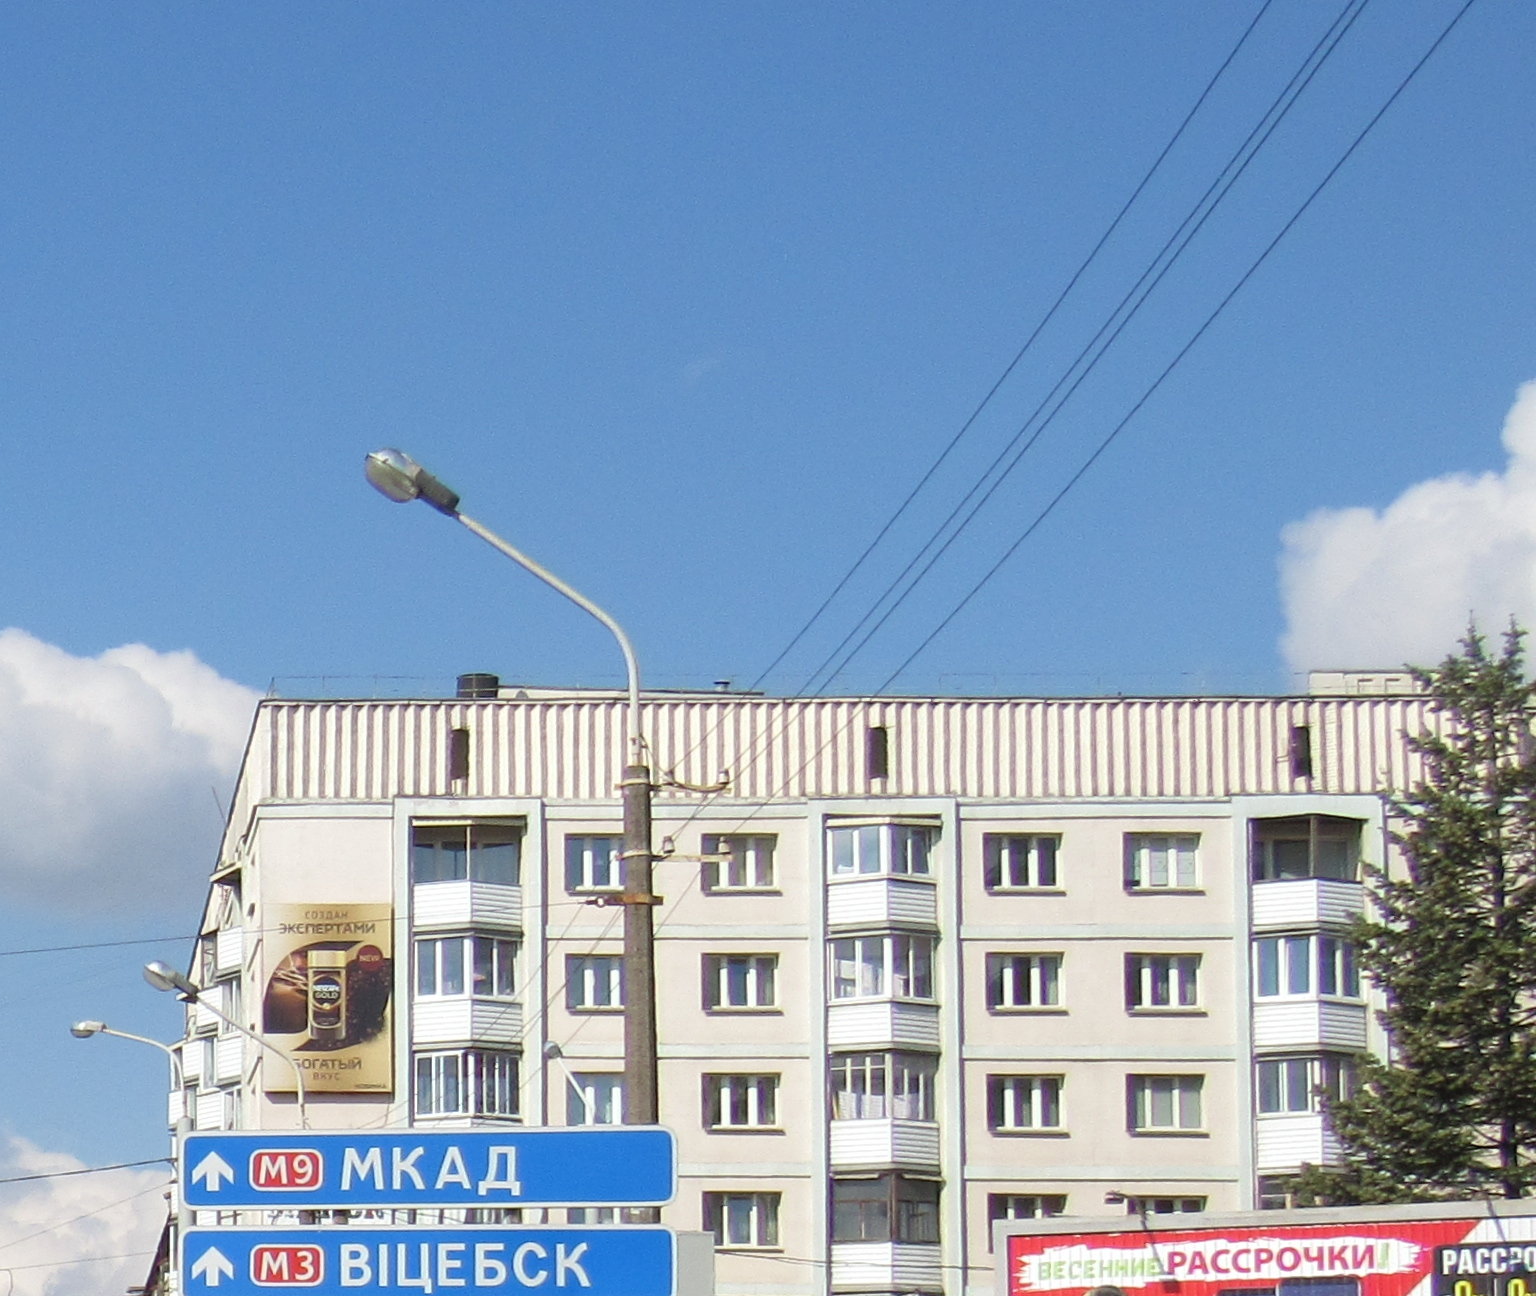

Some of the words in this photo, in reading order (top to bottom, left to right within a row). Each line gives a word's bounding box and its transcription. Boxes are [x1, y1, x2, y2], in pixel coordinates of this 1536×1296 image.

[279, 923, 376, 935] ЭКСПЕРТАМИ
[340, 1146, 521, 1196] МКАД
[339, 1242, 591, 1294] ВІЦЕБСК
[1037, 1256, 1164, 1281] ВЕСЕННИЕ
[1166, 1241, 1390, 1276] РАССРОЧКИ!
